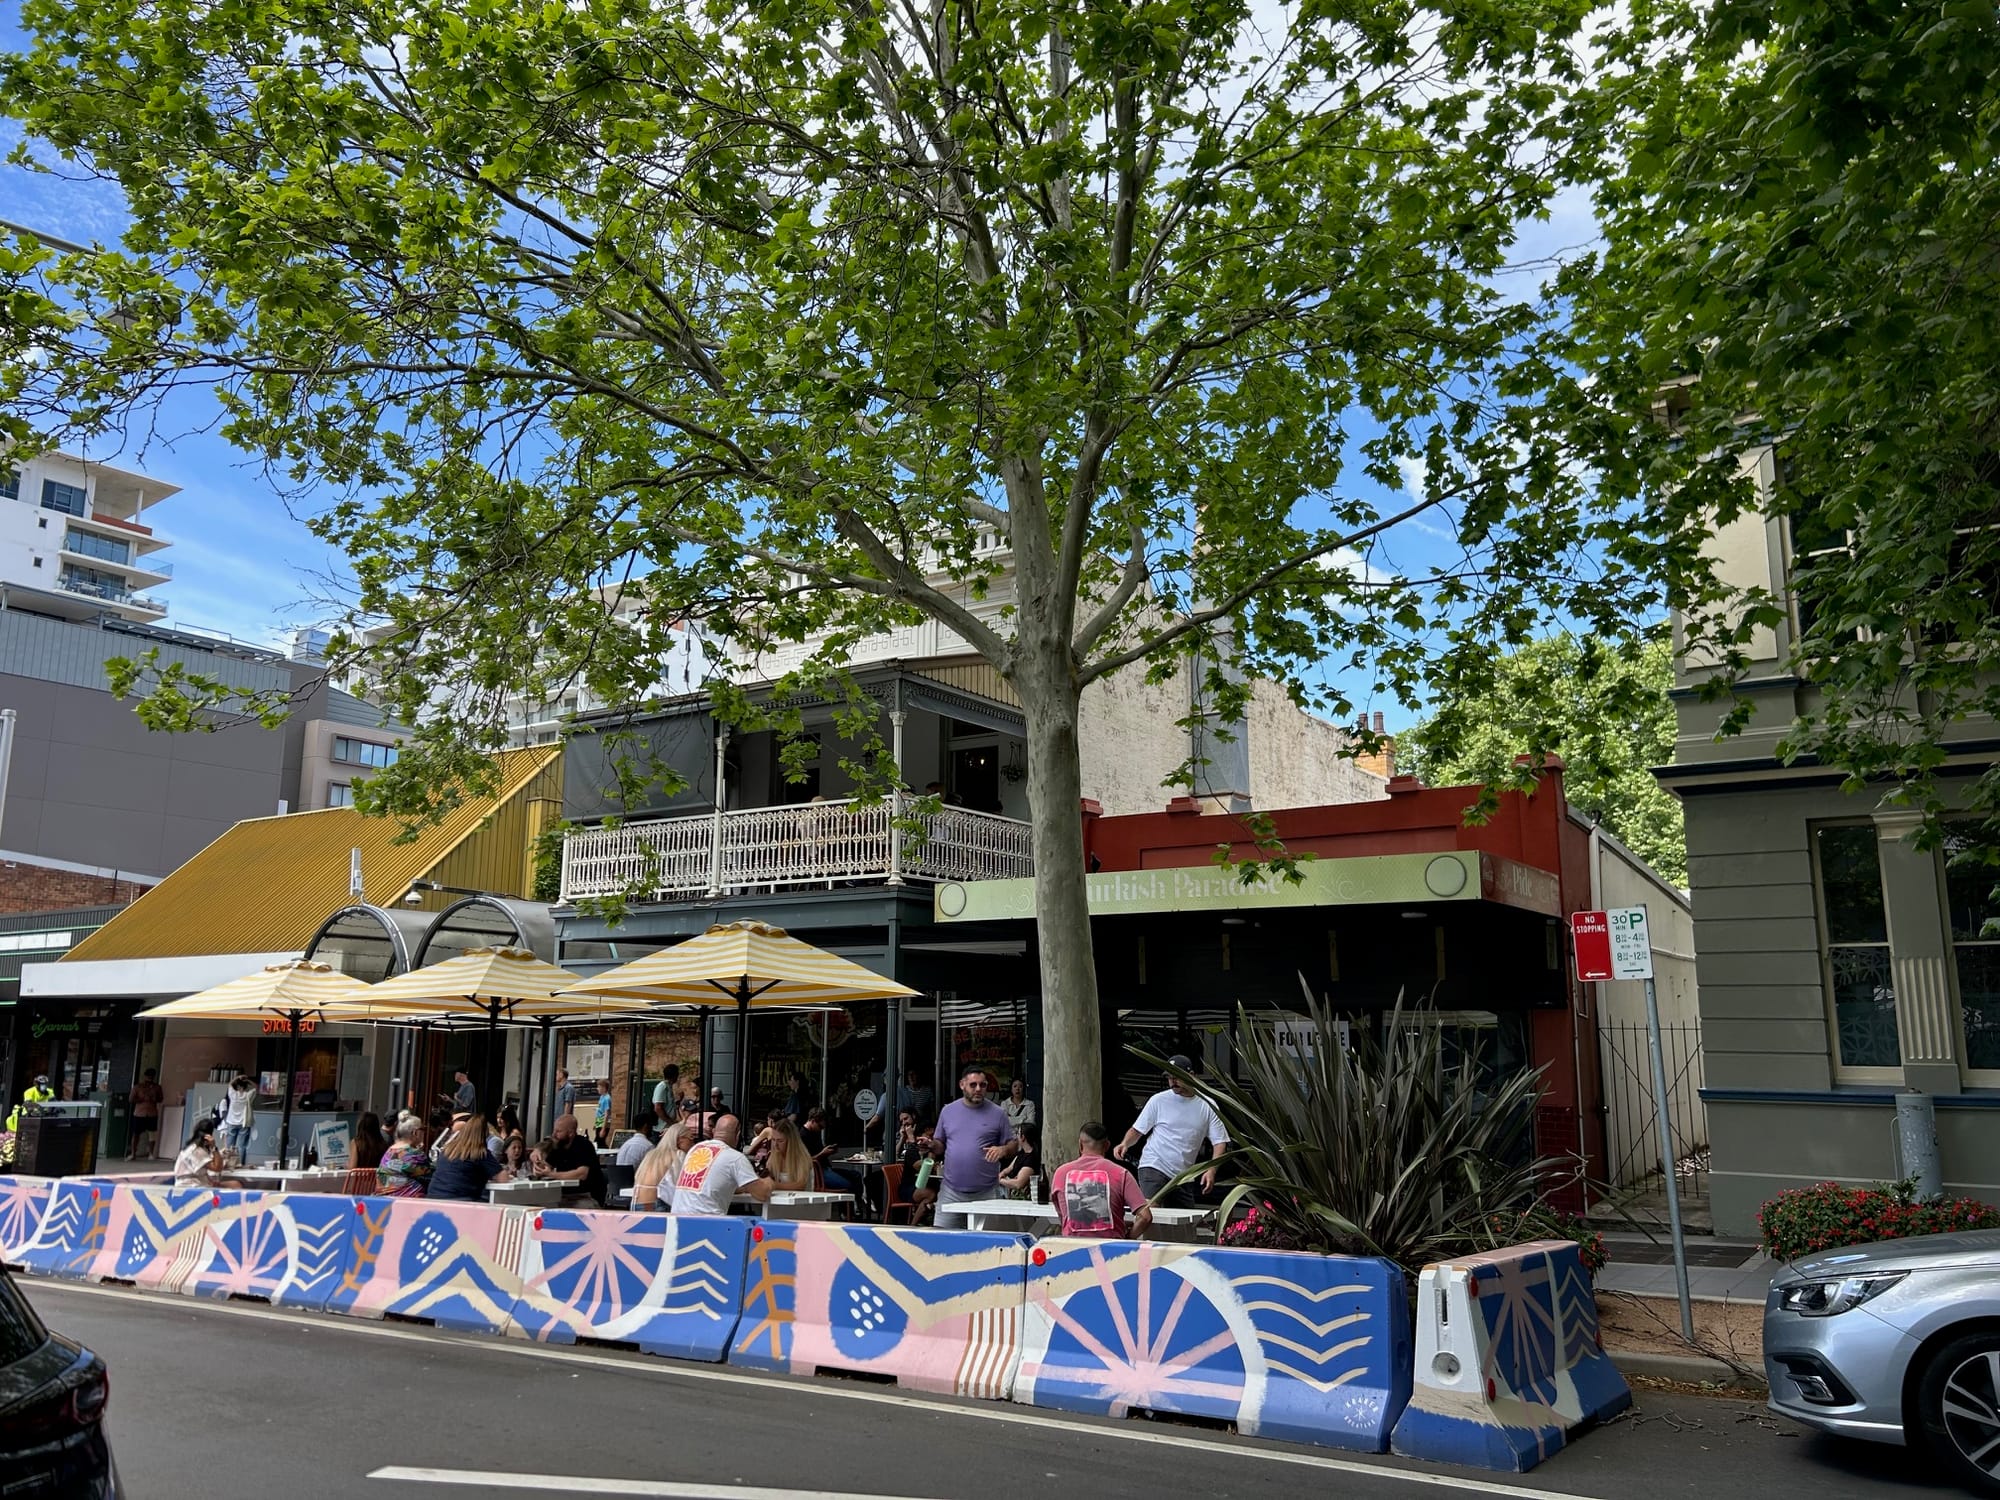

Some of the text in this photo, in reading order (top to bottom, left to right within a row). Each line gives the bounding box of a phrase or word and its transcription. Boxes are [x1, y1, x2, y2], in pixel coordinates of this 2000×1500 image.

[1086, 873, 1166, 902] urkish
[1585, 916, 1595, 924] NO
[1612, 913, 1644, 929] 30 P
[1576, 925, 1606, 934] STOPPING
